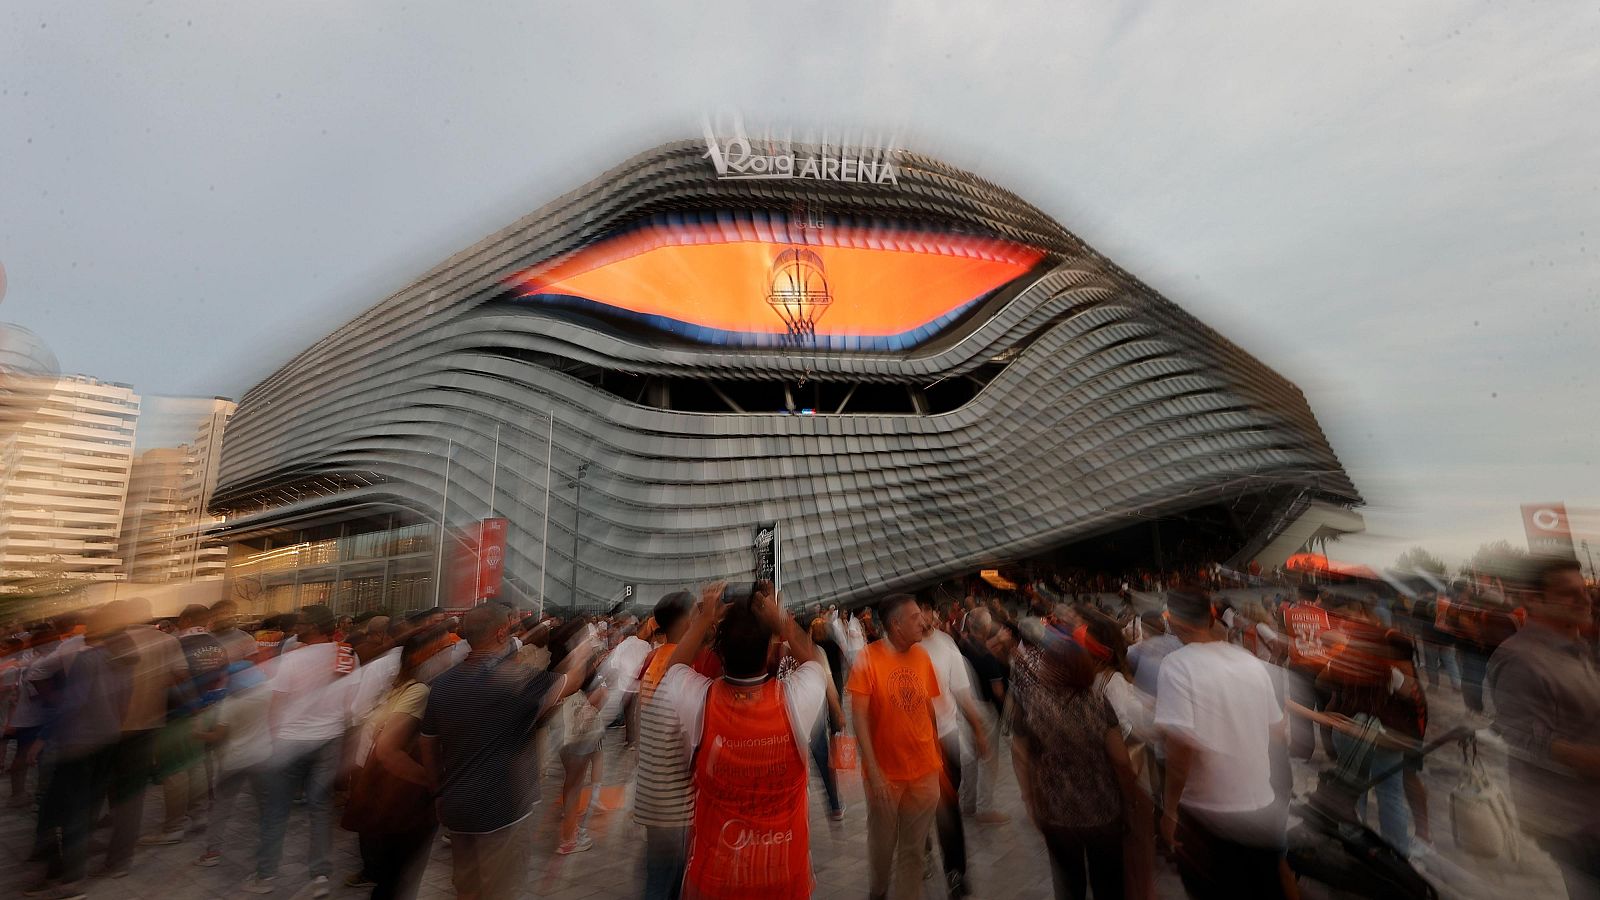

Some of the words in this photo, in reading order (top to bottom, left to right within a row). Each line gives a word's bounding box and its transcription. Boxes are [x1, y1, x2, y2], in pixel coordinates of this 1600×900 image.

[799, 155, 899, 186] ARENA
[626, 585, 632, 596] B
[728, 824, 793, 850] Midea
